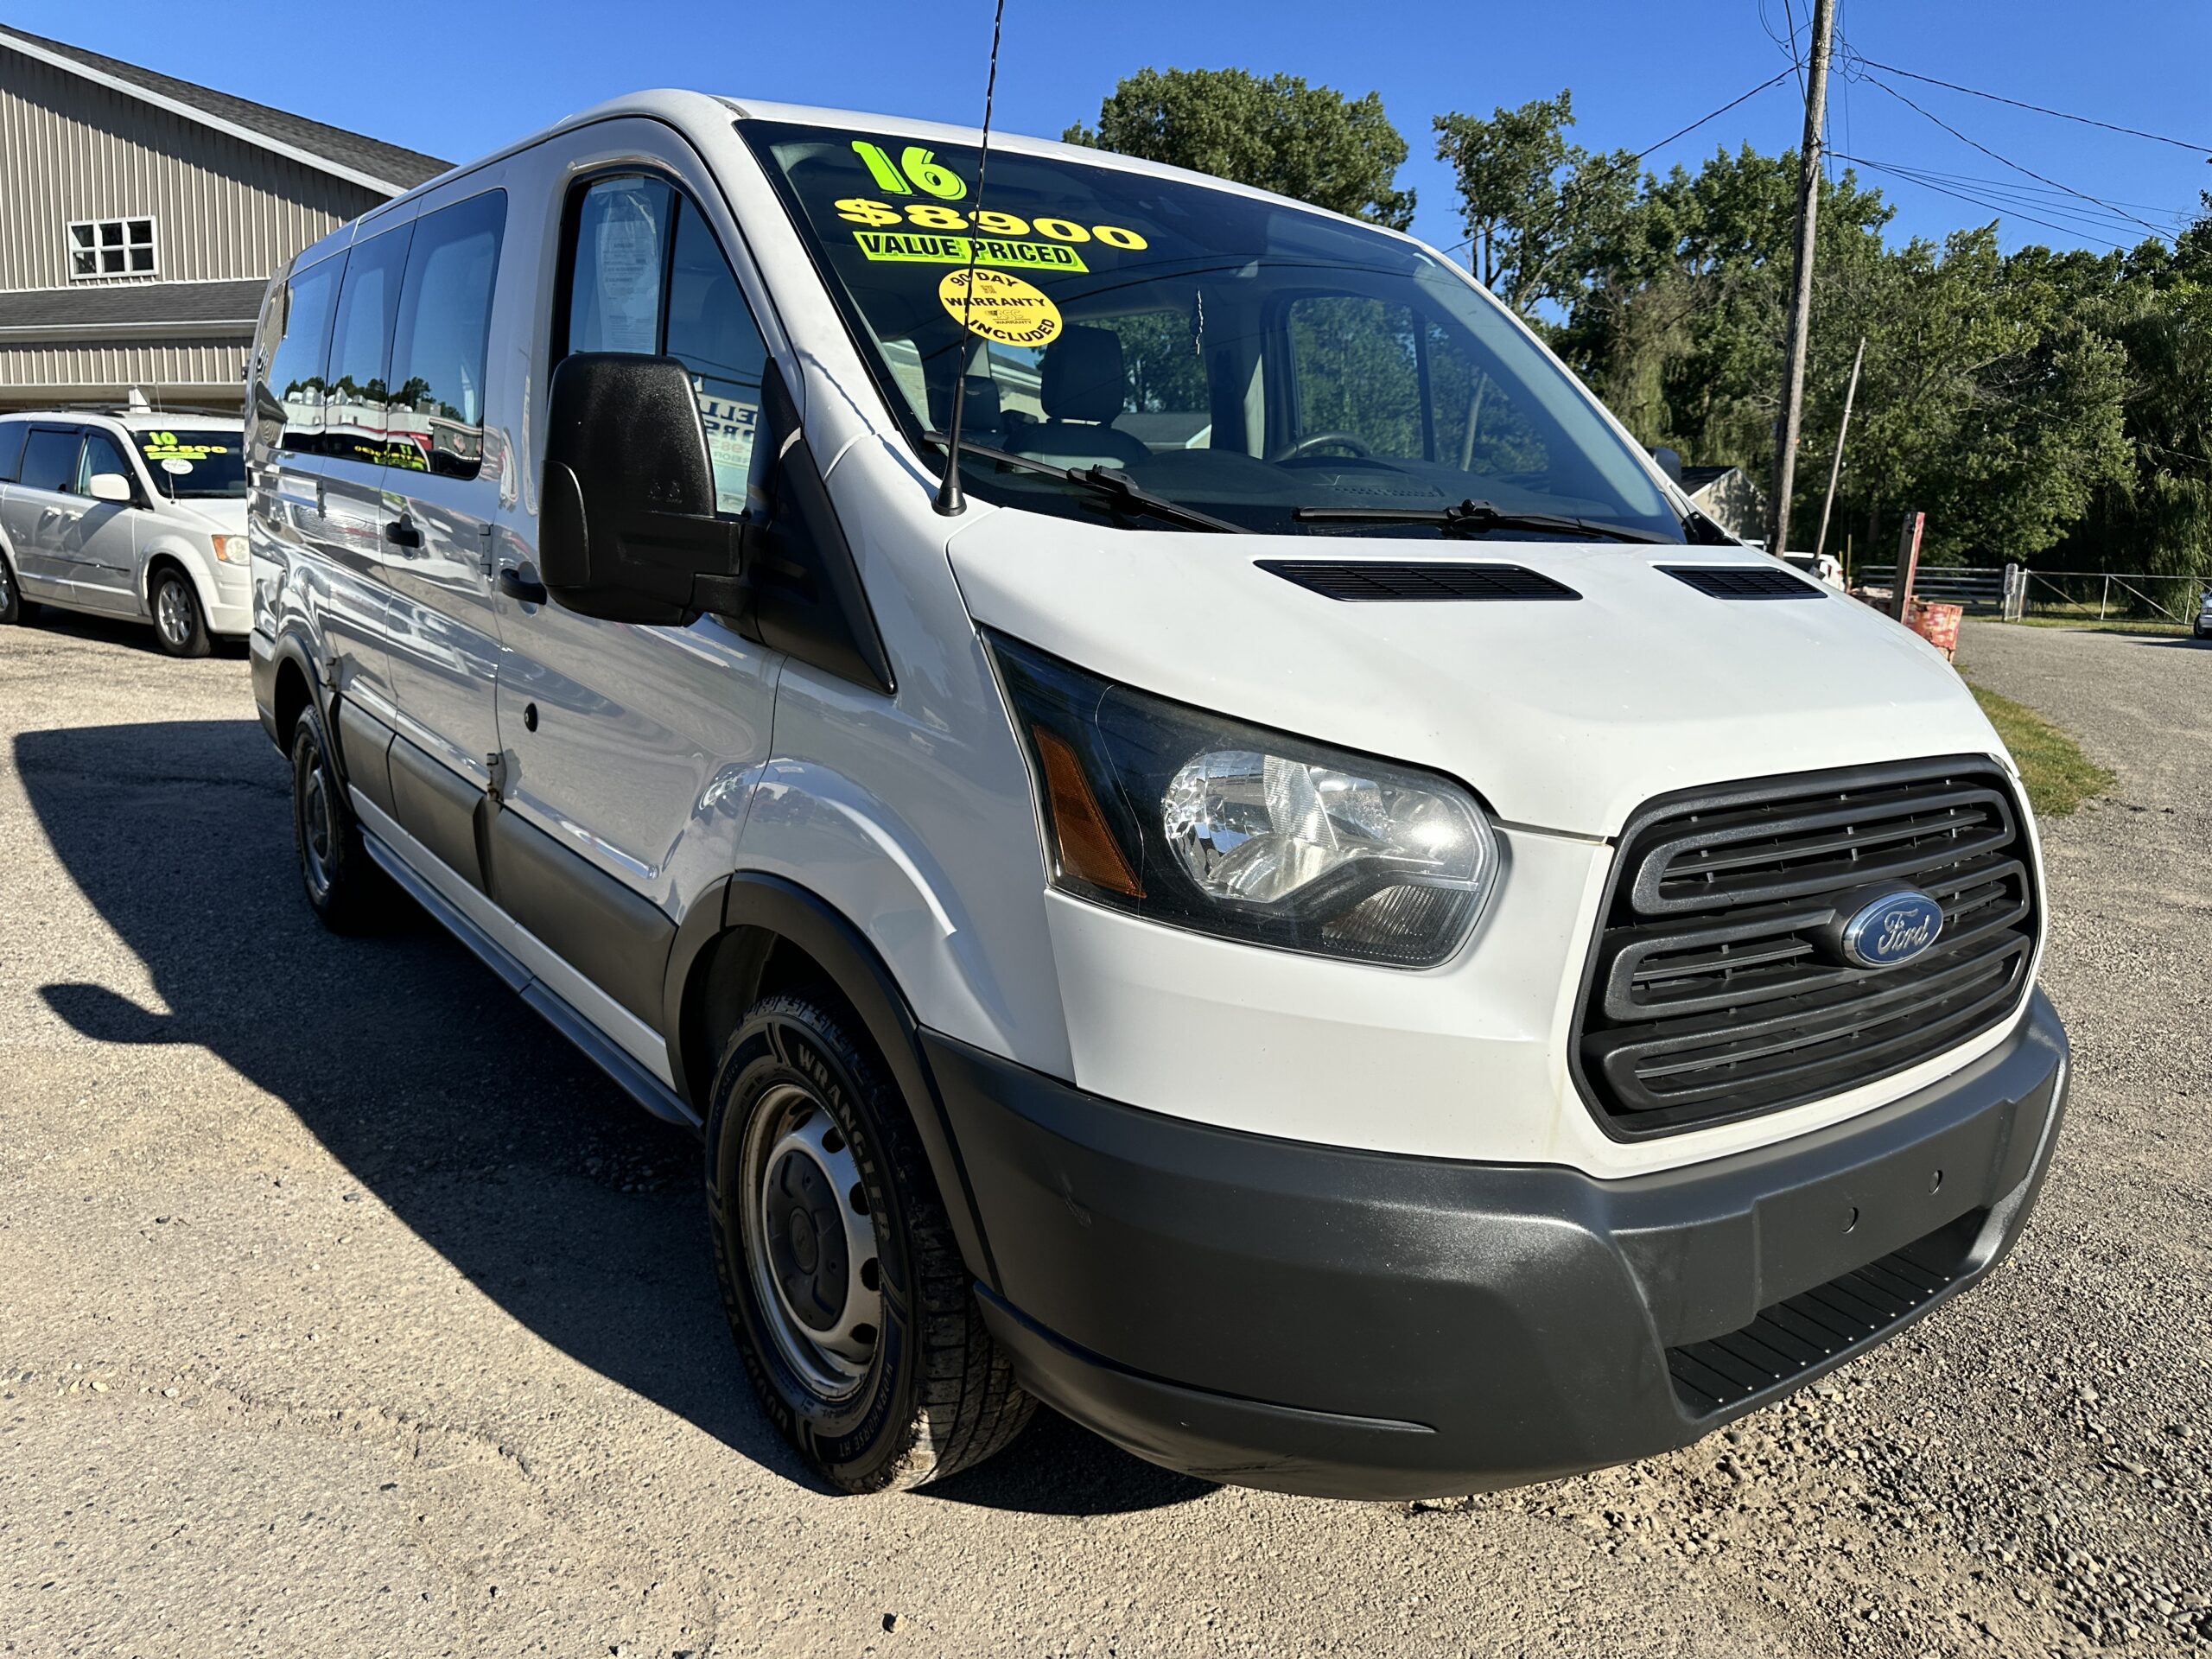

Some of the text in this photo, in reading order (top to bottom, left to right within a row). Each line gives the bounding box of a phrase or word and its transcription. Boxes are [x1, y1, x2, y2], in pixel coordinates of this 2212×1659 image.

[851, 140, 968, 200] 16
[834, 198, 1148, 251] $8900
[861, 232, 1074, 266] VALUE PRICED
[950, 271, 1019, 288] 90 DAY
[944, 297, 1046, 308] WARRANTY
[969, 319, 1055, 342] INCLUDED
[149, 431, 178, 446] 10
[1877, 908, 1930, 955] Ford
[798, 1042, 891, 1241] WRANGLER
[855, 1363, 893, 1451] WORKHORSE
